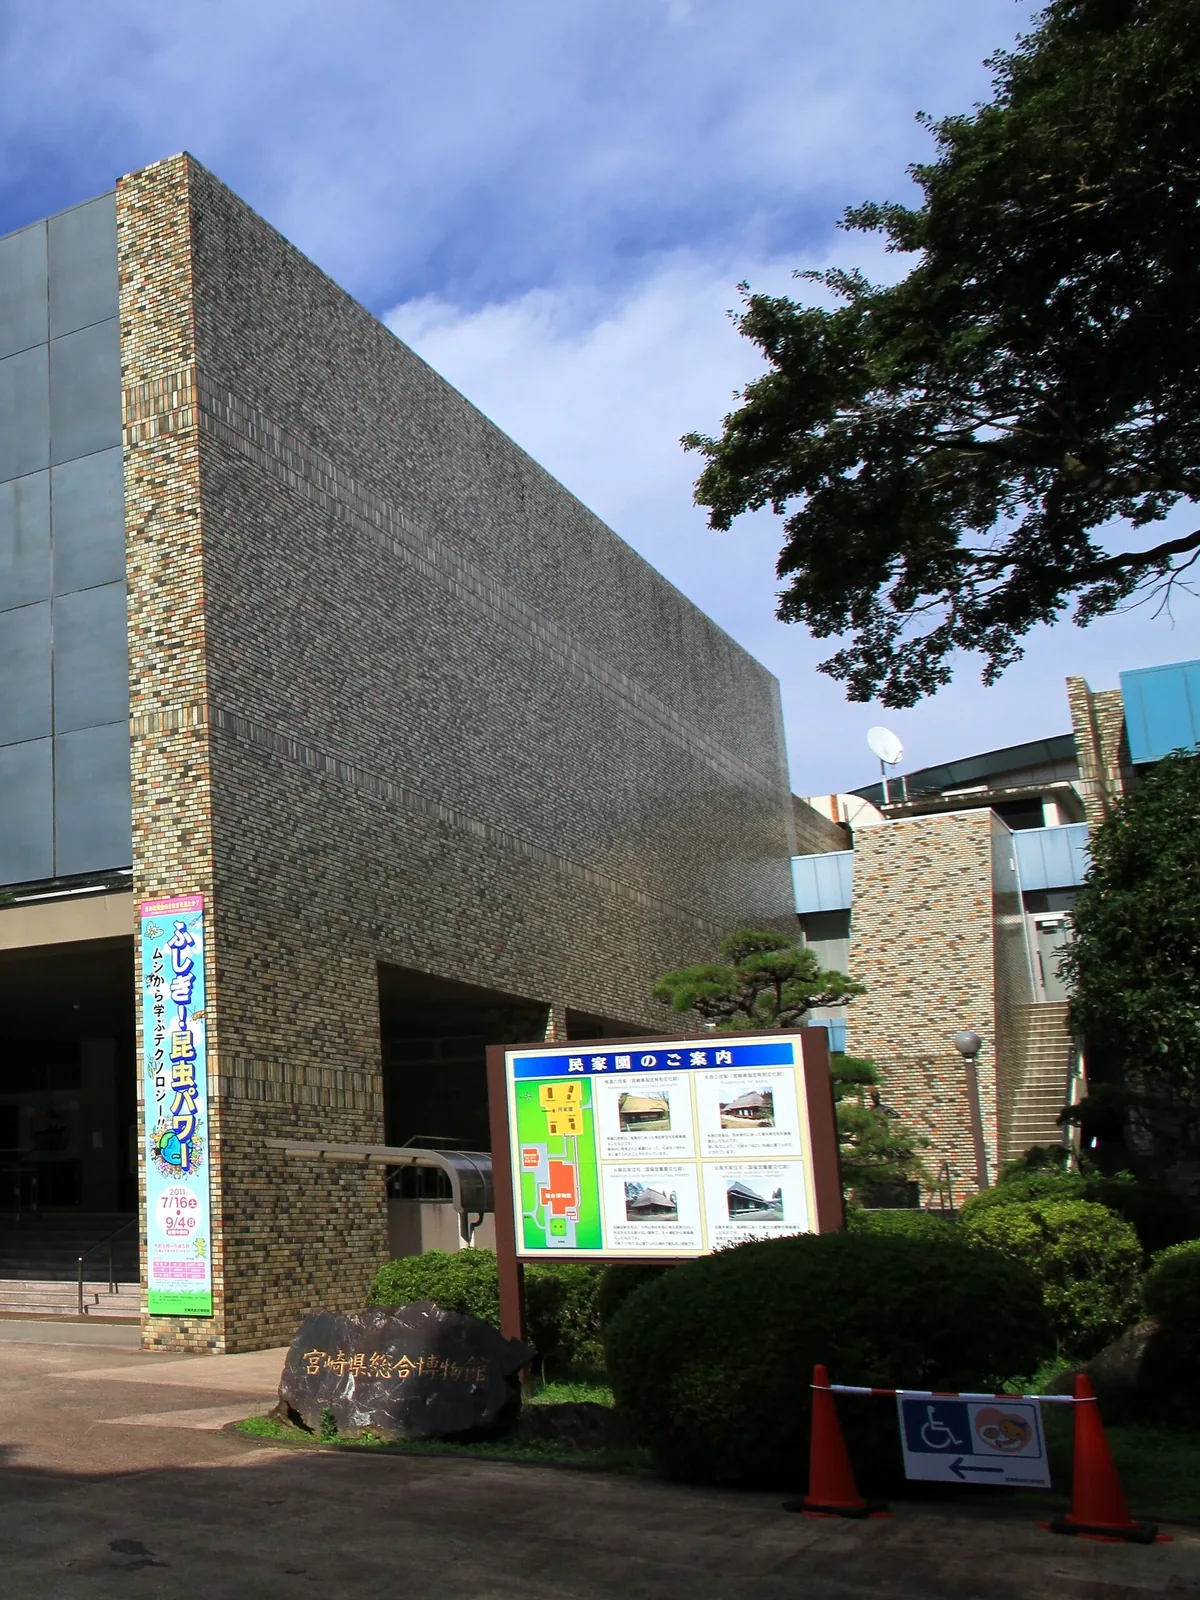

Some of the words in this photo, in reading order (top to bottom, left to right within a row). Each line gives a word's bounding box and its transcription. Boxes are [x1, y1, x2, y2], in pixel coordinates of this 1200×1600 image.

[167, 920, 199, 1172] ふしぎ!昆虫パワー
[568, 1050, 732, 1072] 民家園のご案内
[303, 1348, 490, 1383] 宮崎県総合博物館
